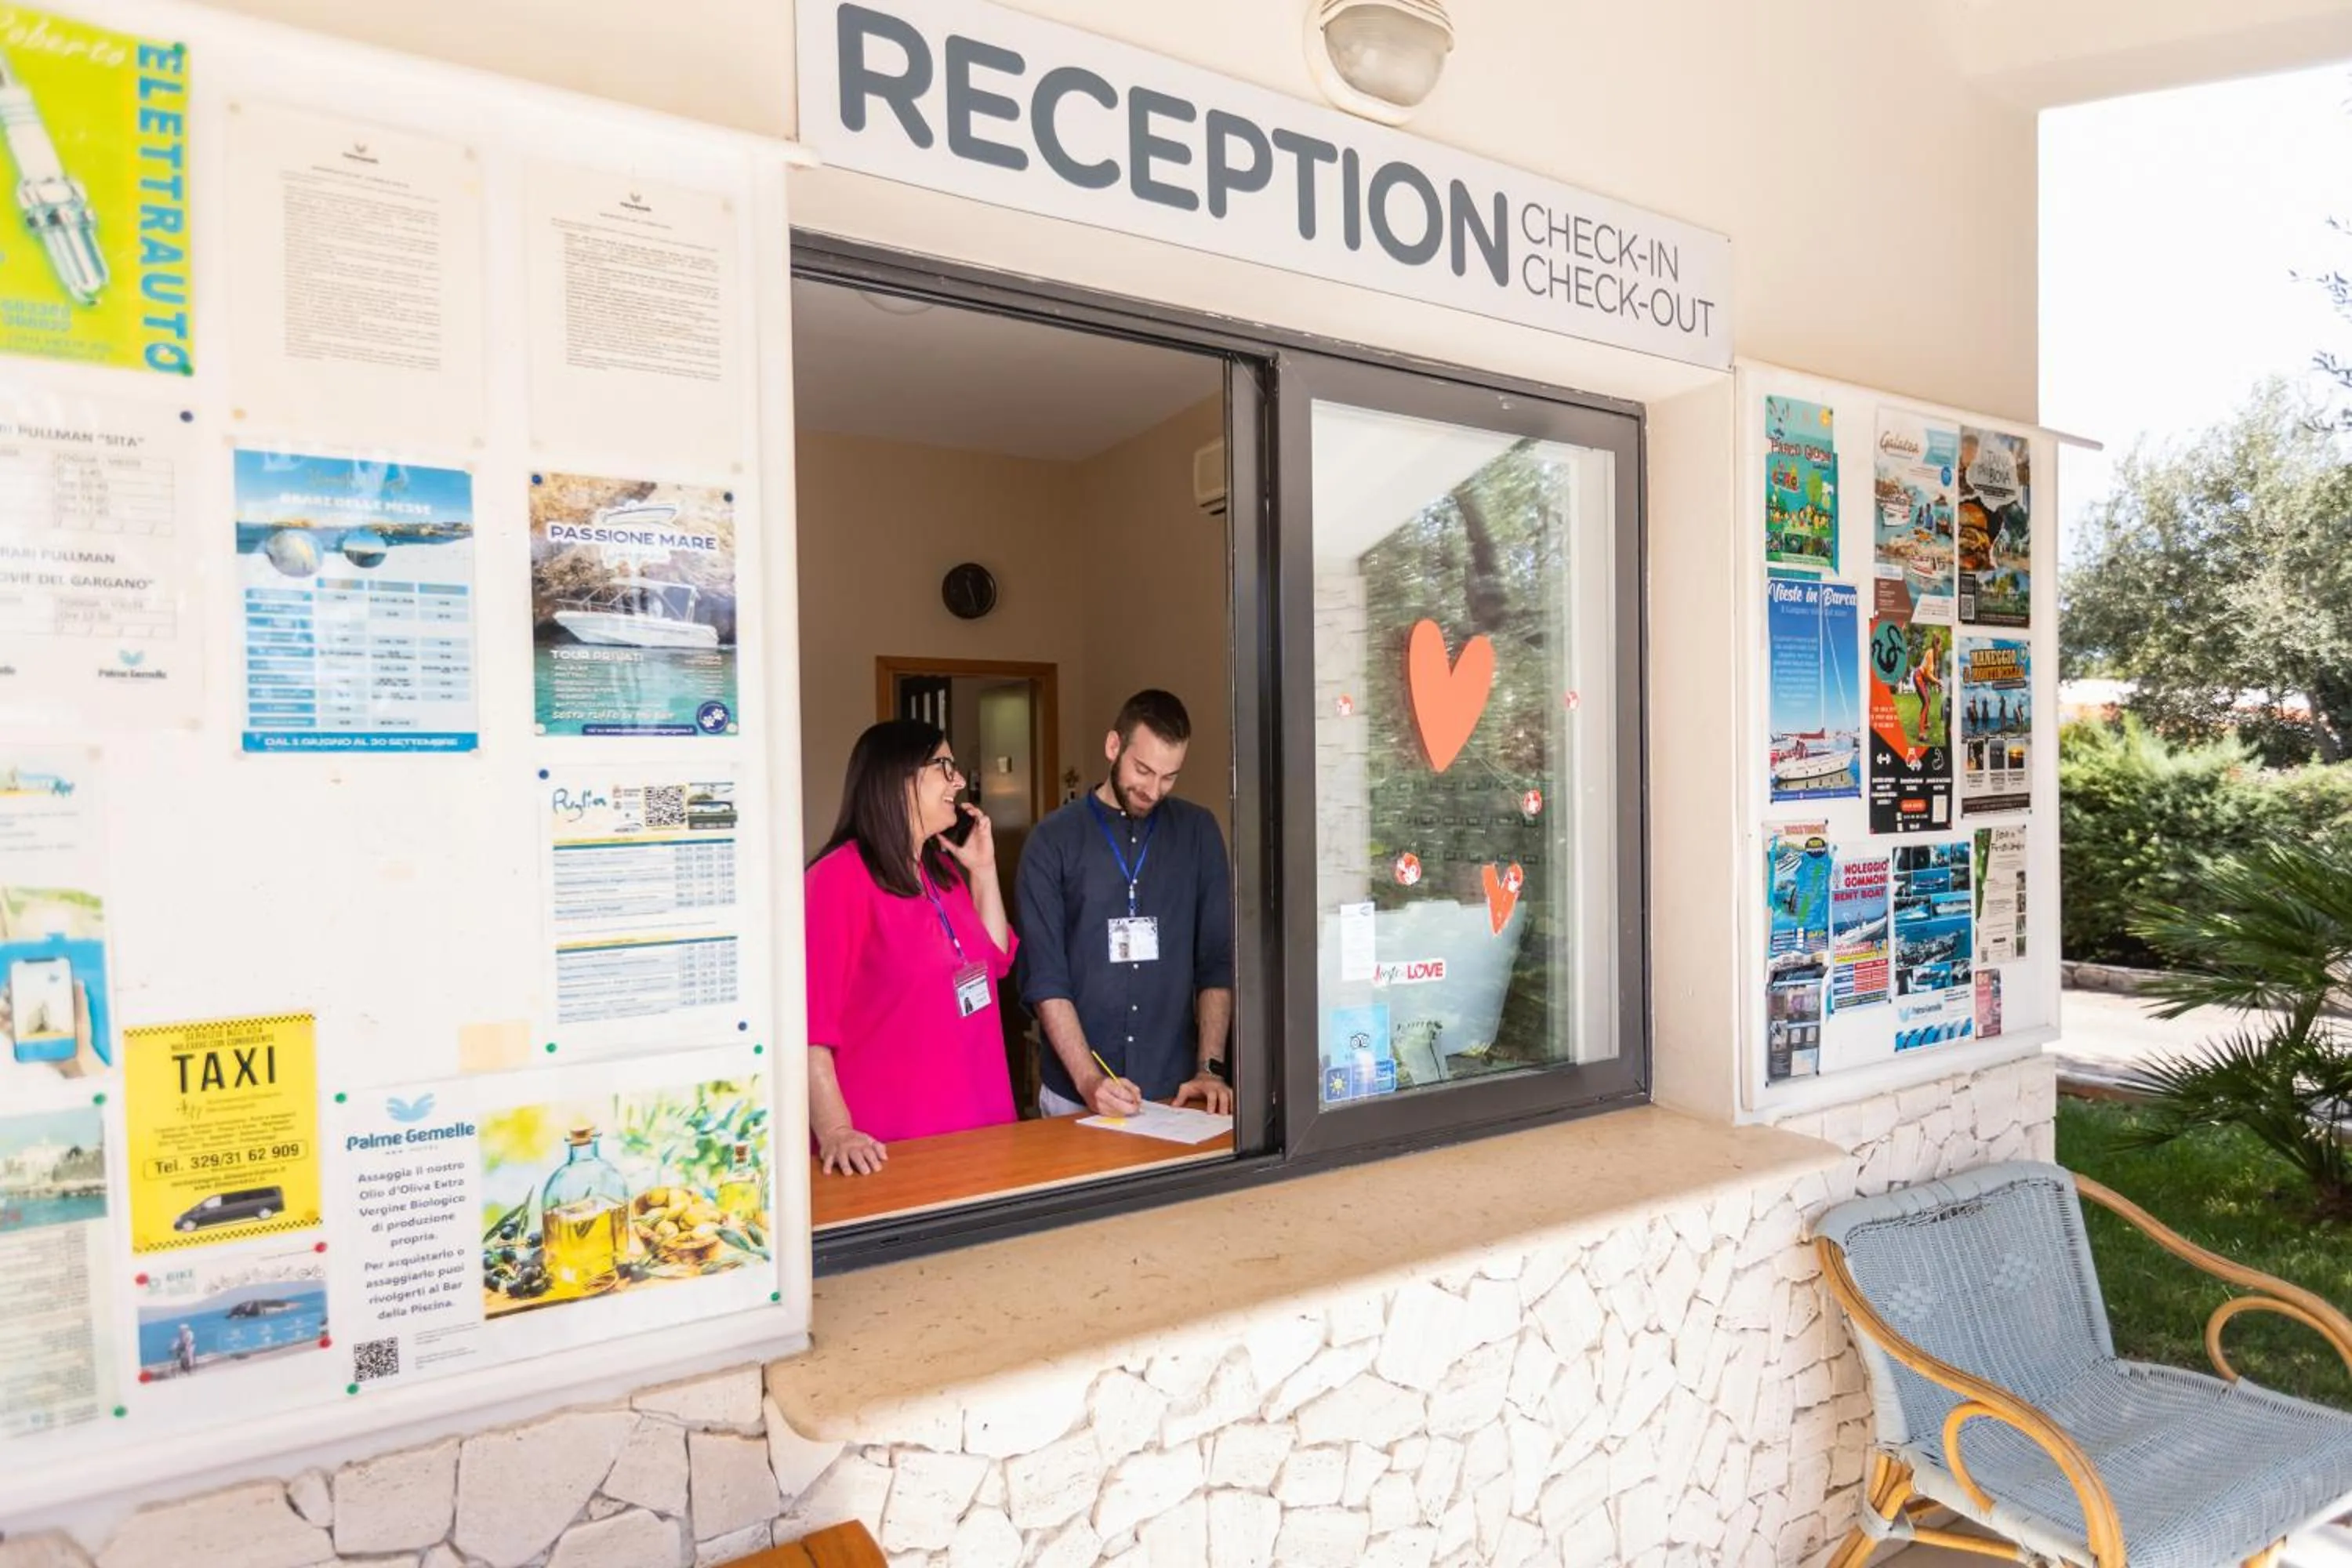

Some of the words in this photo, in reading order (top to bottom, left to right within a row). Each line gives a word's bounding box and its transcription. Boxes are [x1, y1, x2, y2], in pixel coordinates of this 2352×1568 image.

[836, 2, 1510, 288] RECEPTION
[136, 42, 190, 374] ELETTRAUTO
[1522, 203, 1678, 282] CHECK-IN
[1523, 254, 1715, 337] CHECK-OUT
[18, 425, 93, 443] PULLMAN
[550, 525, 654, 546] PASSIONE
[659, 533, 717, 550] MARE
[42, 549, 115, 564] PULLMAN
[550, 650, 589, 660] TOUR
[1407, 962, 1443, 979] LOVE
[171, 1045, 276, 1094] TAXI
[347, 1133, 402, 1151] Palme
[405, 1122, 476, 1143] Gemelle
[154, 1161, 184, 1174] Tel.
[191, 1151, 241, 1171] 329/31
[249, 1148, 267, 1161] 62
[272, 1143, 299, 1158] 909
[426, 1161, 465, 1174] nostro
[359, 1190, 385, 1200] Olio
[388, 1182, 430, 1196] d'Oliva
[434, 1178, 465, 1189] Extra
[359, 1203, 407, 1217] Vergine
[409, 1195, 466, 1209] Biologico
[372, 1222, 383, 1232] di
[387, 1213, 456, 1232] produzione
[365, 1261, 383, 1271] Per
[388, 1249, 455, 1268] acquistarlo
[457, 1248, 465, 1257] o
[366, 1269, 435, 1288] assaggiarlo
[437, 1261, 465, 1278] puoi
[368, 1287, 426, 1305] rivolgerti
[428, 1283, 440, 1294] al
[443, 1282, 463, 1291] Bar
[376, 1308, 407, 1320] della
